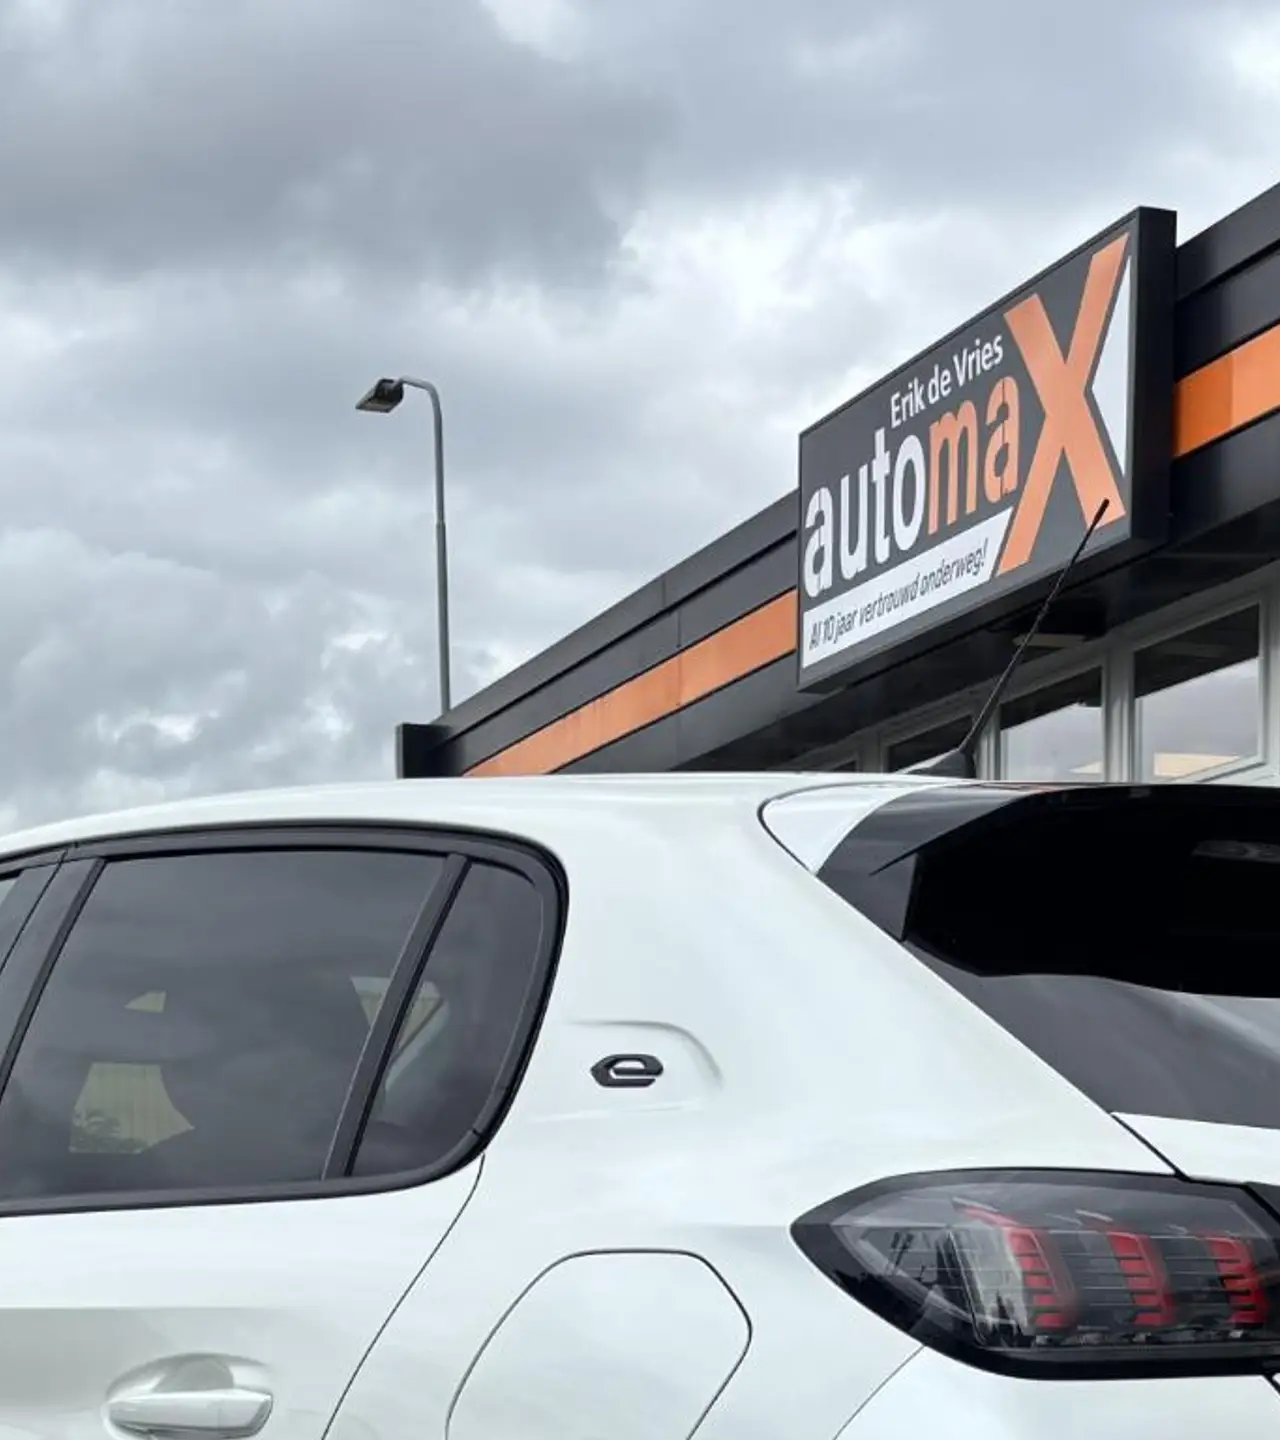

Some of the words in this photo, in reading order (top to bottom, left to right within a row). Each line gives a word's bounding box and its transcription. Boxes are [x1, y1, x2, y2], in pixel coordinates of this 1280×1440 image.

[891, 377, 926, 428] Erik
[928, 363, 952, 404] de
[953, 335, 1003, 387] Vries
[822, 614, 835, 641] 10
[833, 608, 858, 644] jaar
[859, 571, 920, 626] vertrouwd
[920, 537, 988, 595] onderweg!
